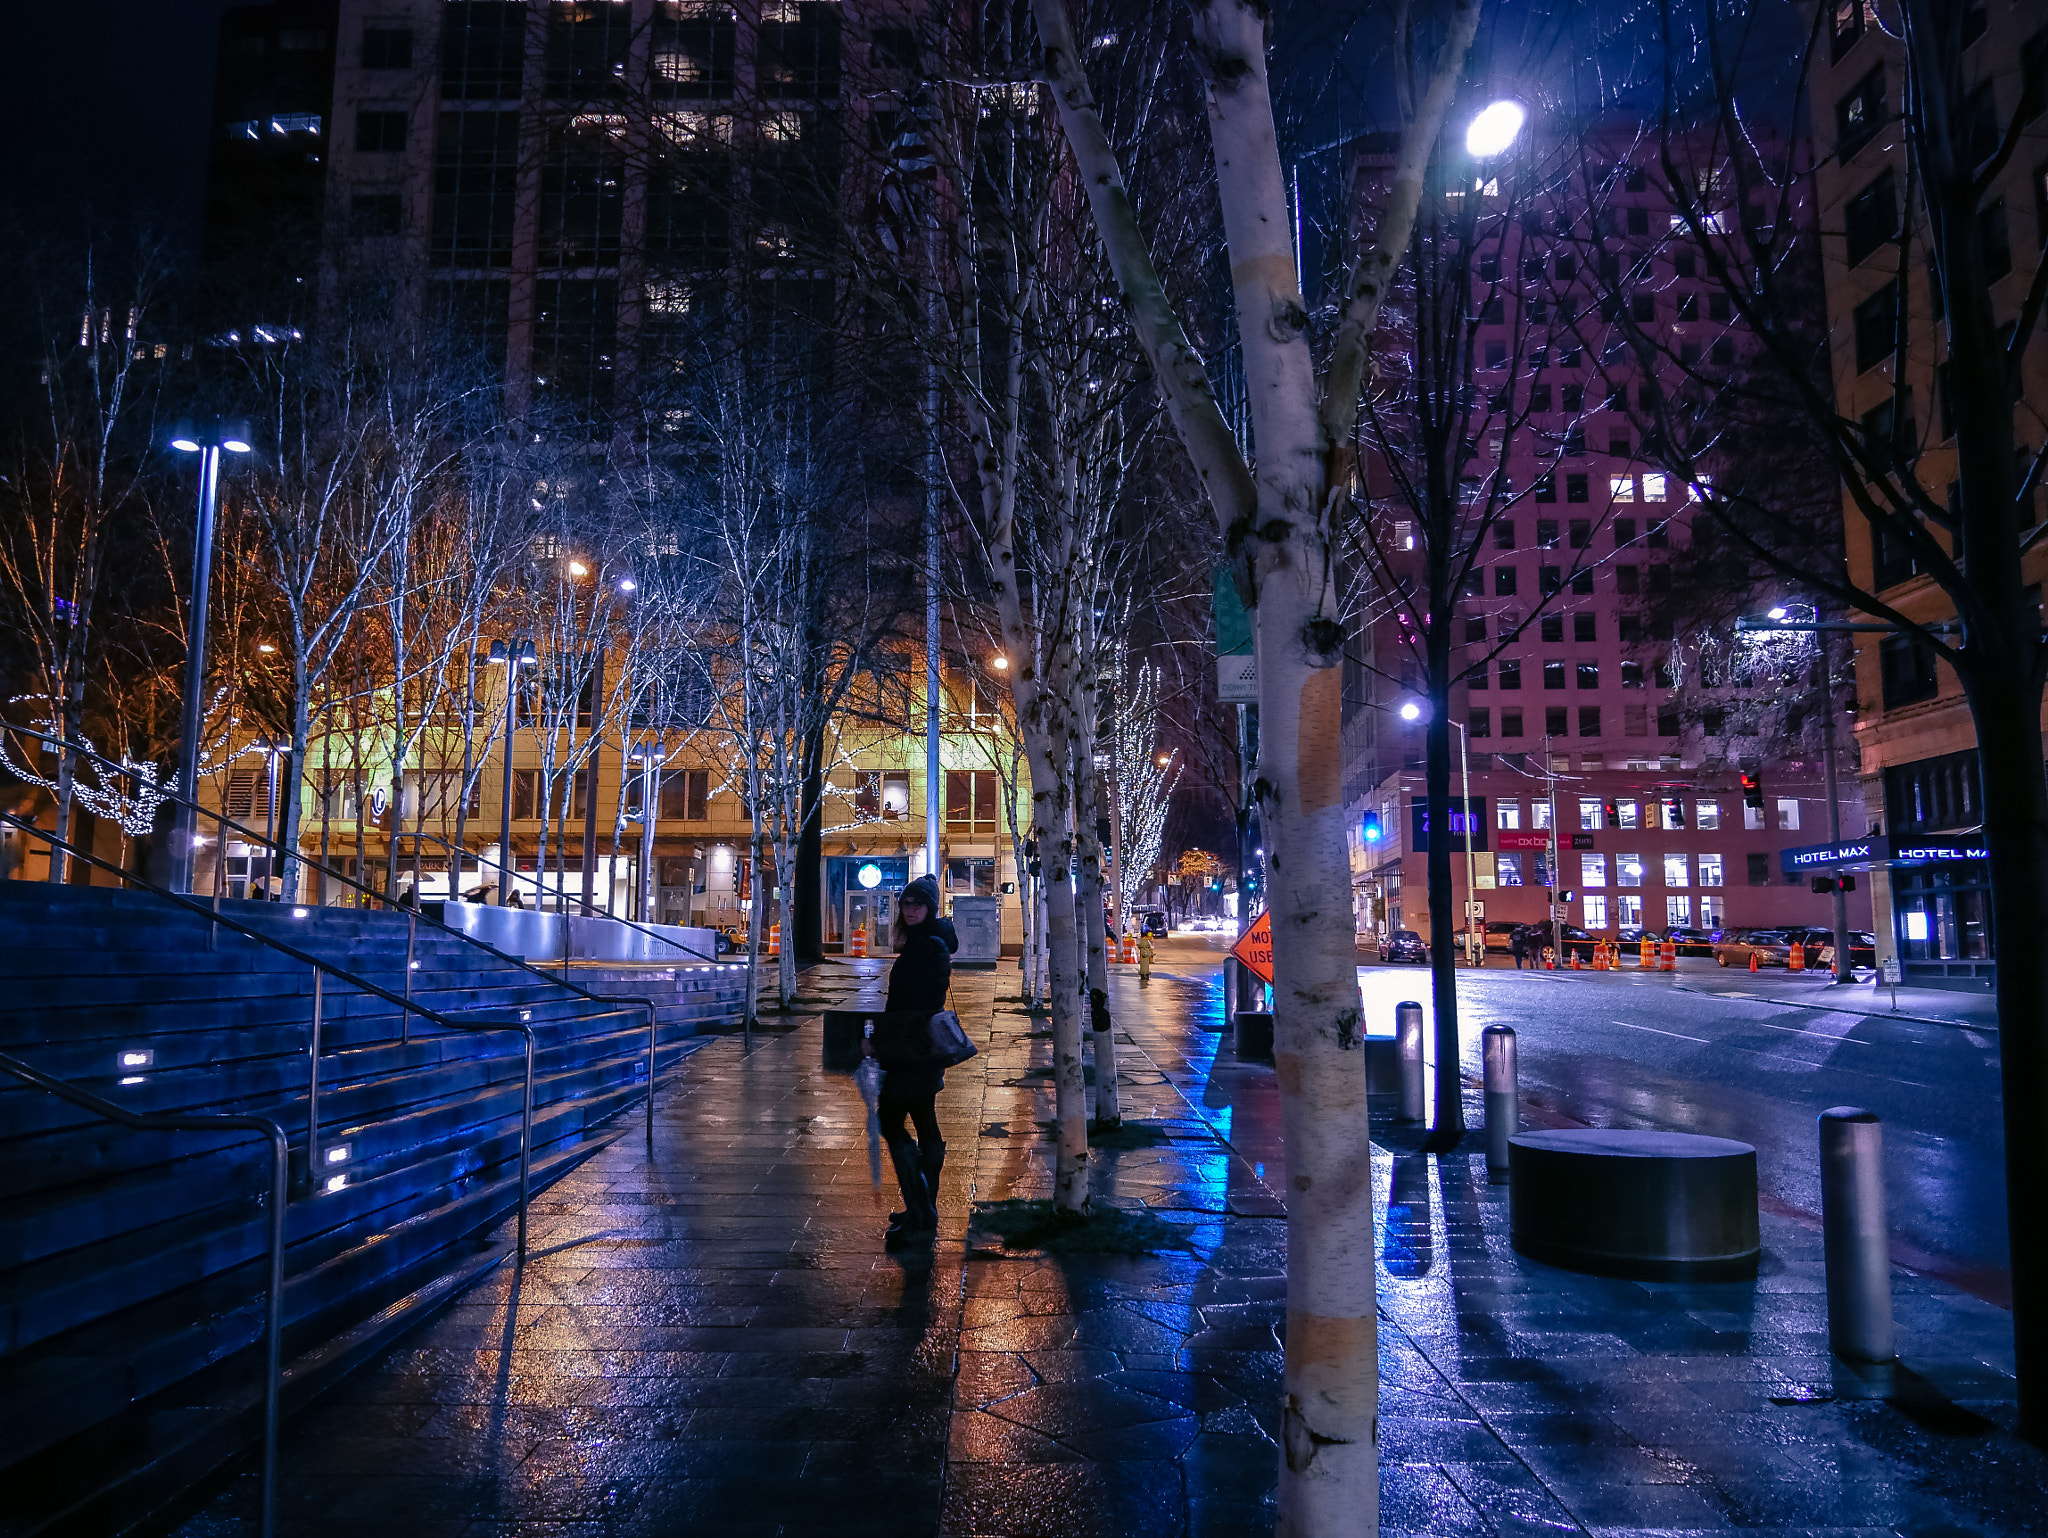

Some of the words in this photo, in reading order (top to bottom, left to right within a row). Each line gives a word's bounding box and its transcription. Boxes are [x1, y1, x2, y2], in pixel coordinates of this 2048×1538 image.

[1794, 850, 1839, 864] HOTEL
[1839, 845, 1869, 859] MAX
[1899, 849, 1964, 858] HOTEL
